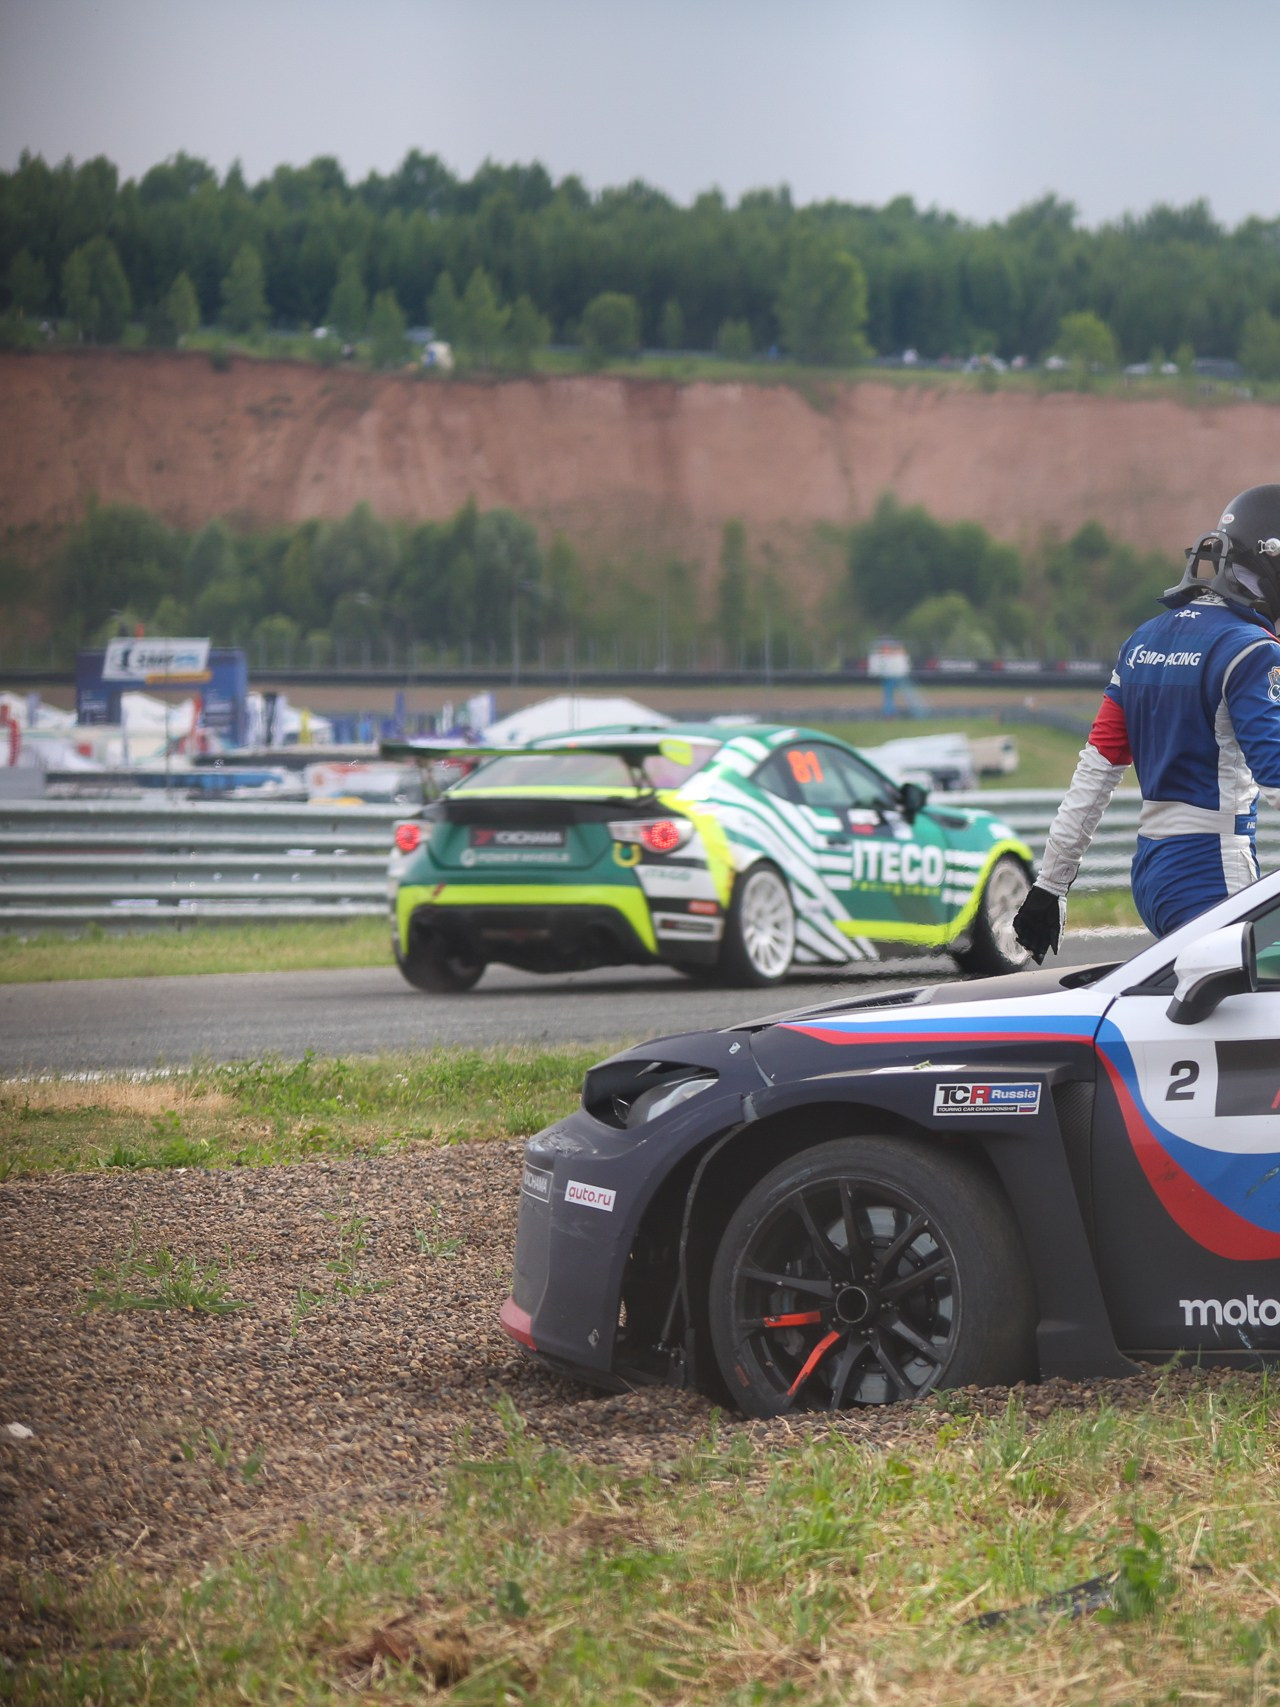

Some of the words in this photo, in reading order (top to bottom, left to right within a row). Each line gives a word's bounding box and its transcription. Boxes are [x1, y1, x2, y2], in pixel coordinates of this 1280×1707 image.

[1136, 650, 1166, 666] SMP
[852, 840, 943, 886] ITECO
[1165, 1060, 1200, 1101] 2
[938, 1085, 991, 1104] TCR
[991, 1088, 1036, 1099] Russia
[569, 1186, 612, 1205] auto.ru
